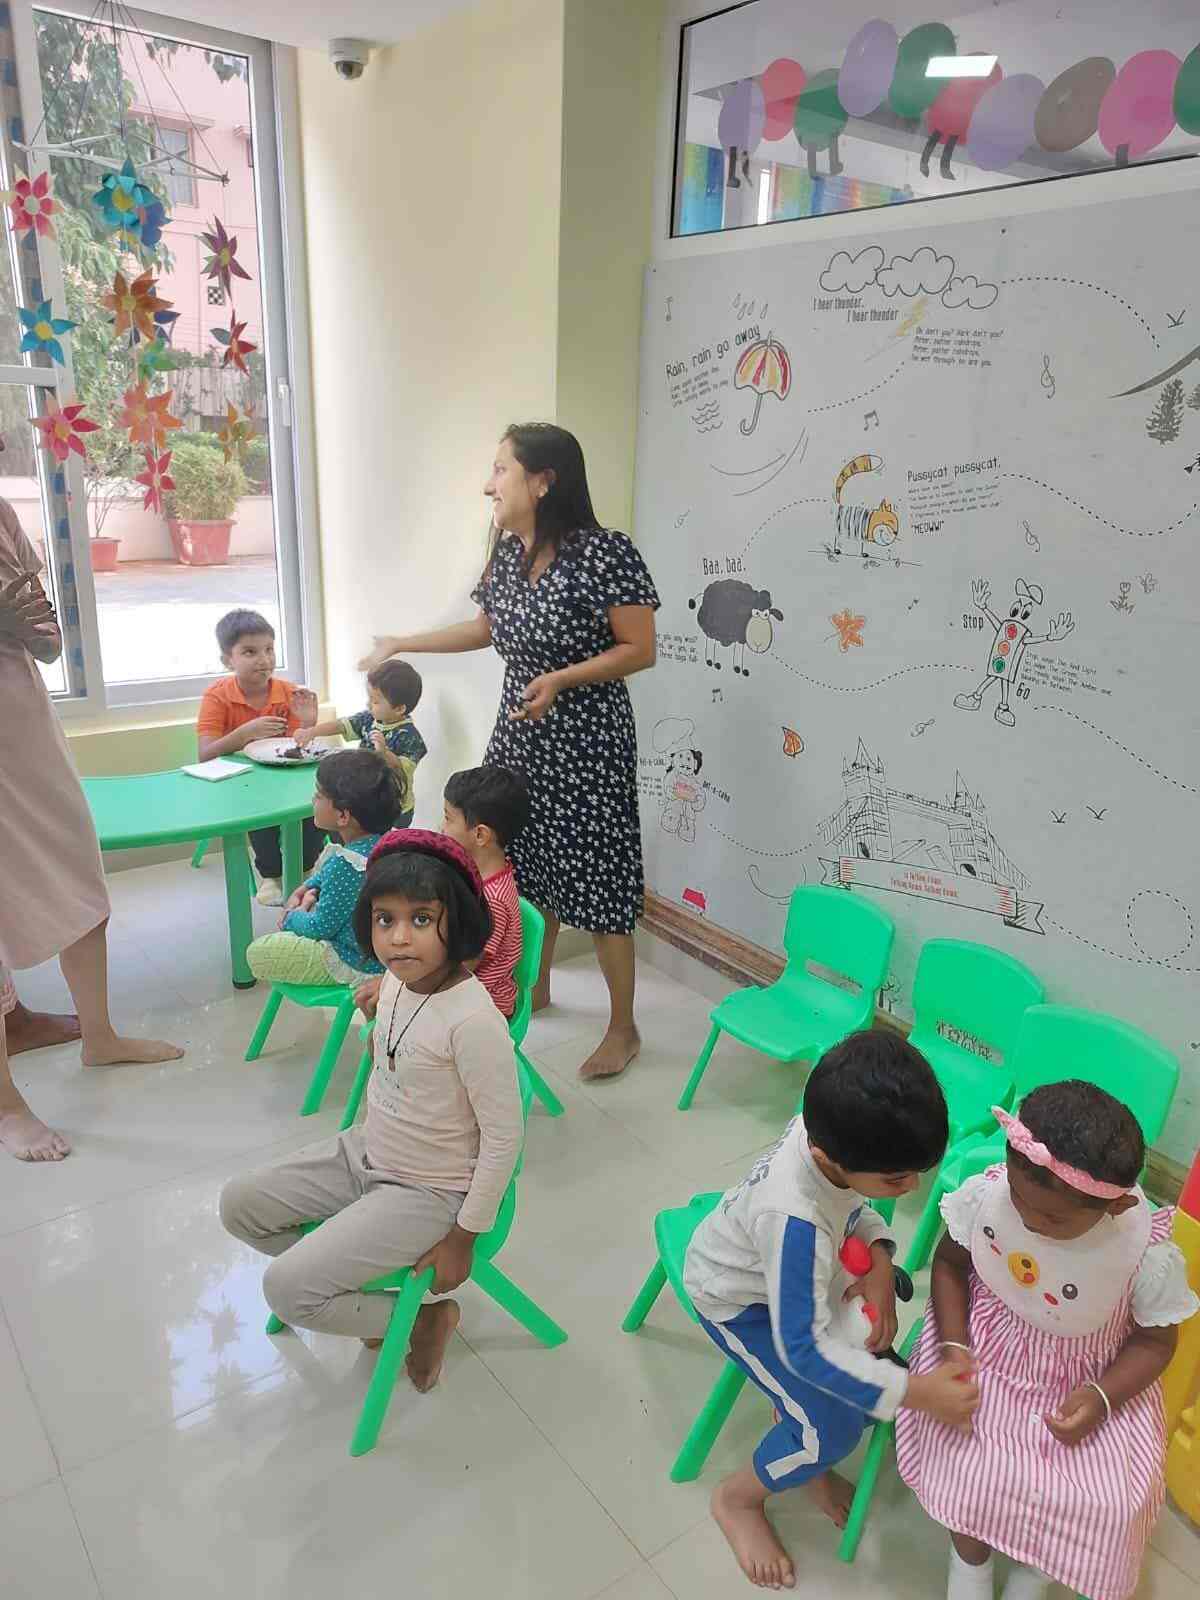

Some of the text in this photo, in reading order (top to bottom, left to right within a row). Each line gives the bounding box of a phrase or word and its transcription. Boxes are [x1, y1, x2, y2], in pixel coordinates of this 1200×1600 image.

[692, 347, 712, 368] rain
[716, 339, 730, 360] go
[735, 324, 761, 346] away
[907, 466, 948, 483] Pussycat
[962, 613, 984, 632] Stop
